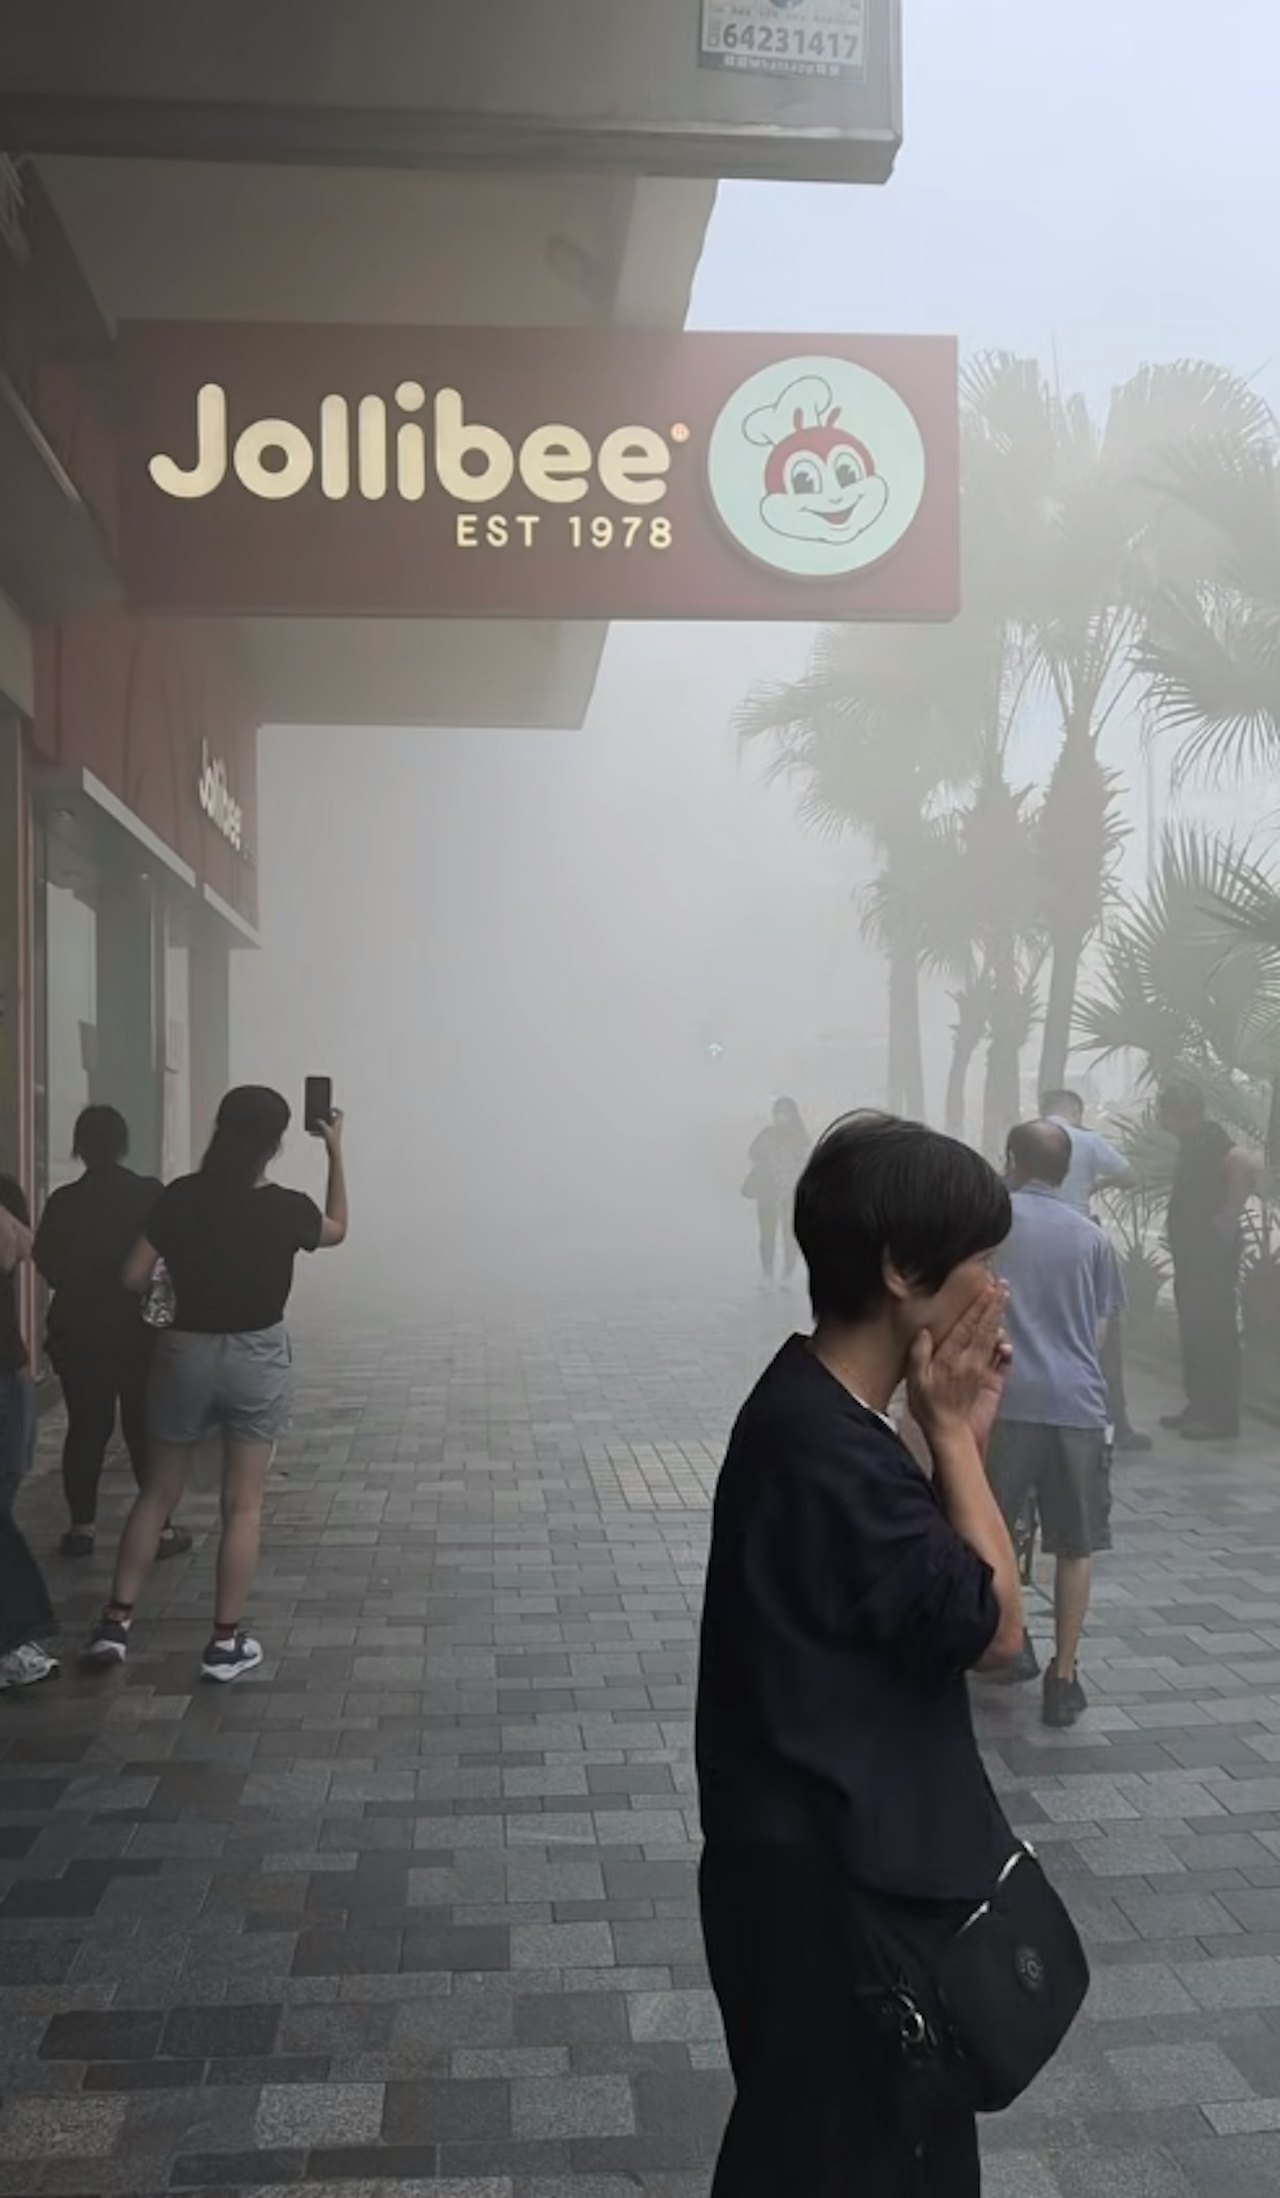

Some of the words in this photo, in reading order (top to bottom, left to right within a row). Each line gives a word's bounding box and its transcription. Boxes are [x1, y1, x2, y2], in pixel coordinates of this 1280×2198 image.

[722, 23, 858, 60] 64231417
[149, 381, 671, 504] Jollibee
[457, 514, 540, 547] EST
[569, 516, 673, 548] 1978
